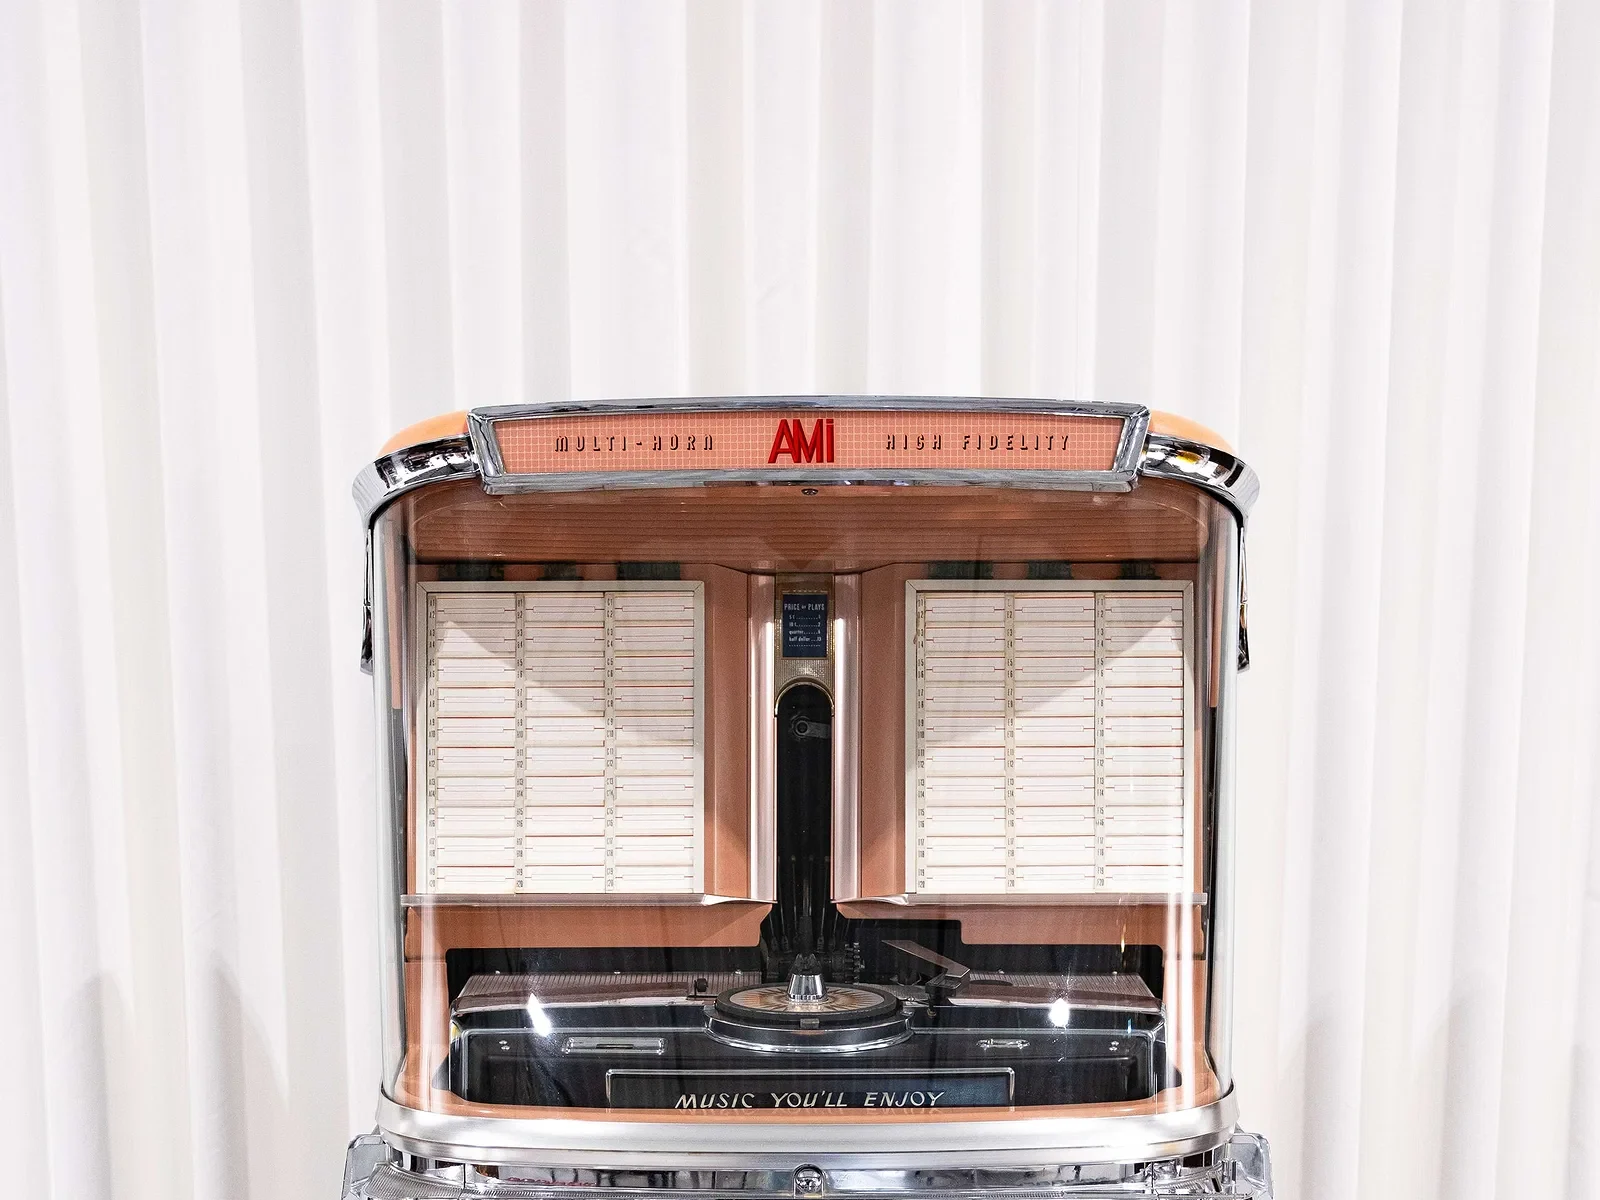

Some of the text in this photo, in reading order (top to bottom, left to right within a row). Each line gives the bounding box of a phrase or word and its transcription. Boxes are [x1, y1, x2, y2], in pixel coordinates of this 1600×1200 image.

[554, 434, 714, 452] MULTI-HORN
[885, 434, 942, 450] HIGH
[962, 434, 1070, 451] FIDELITY
[675, 1091, 946, 1108] MUSIC YOU'LL ENJOY
